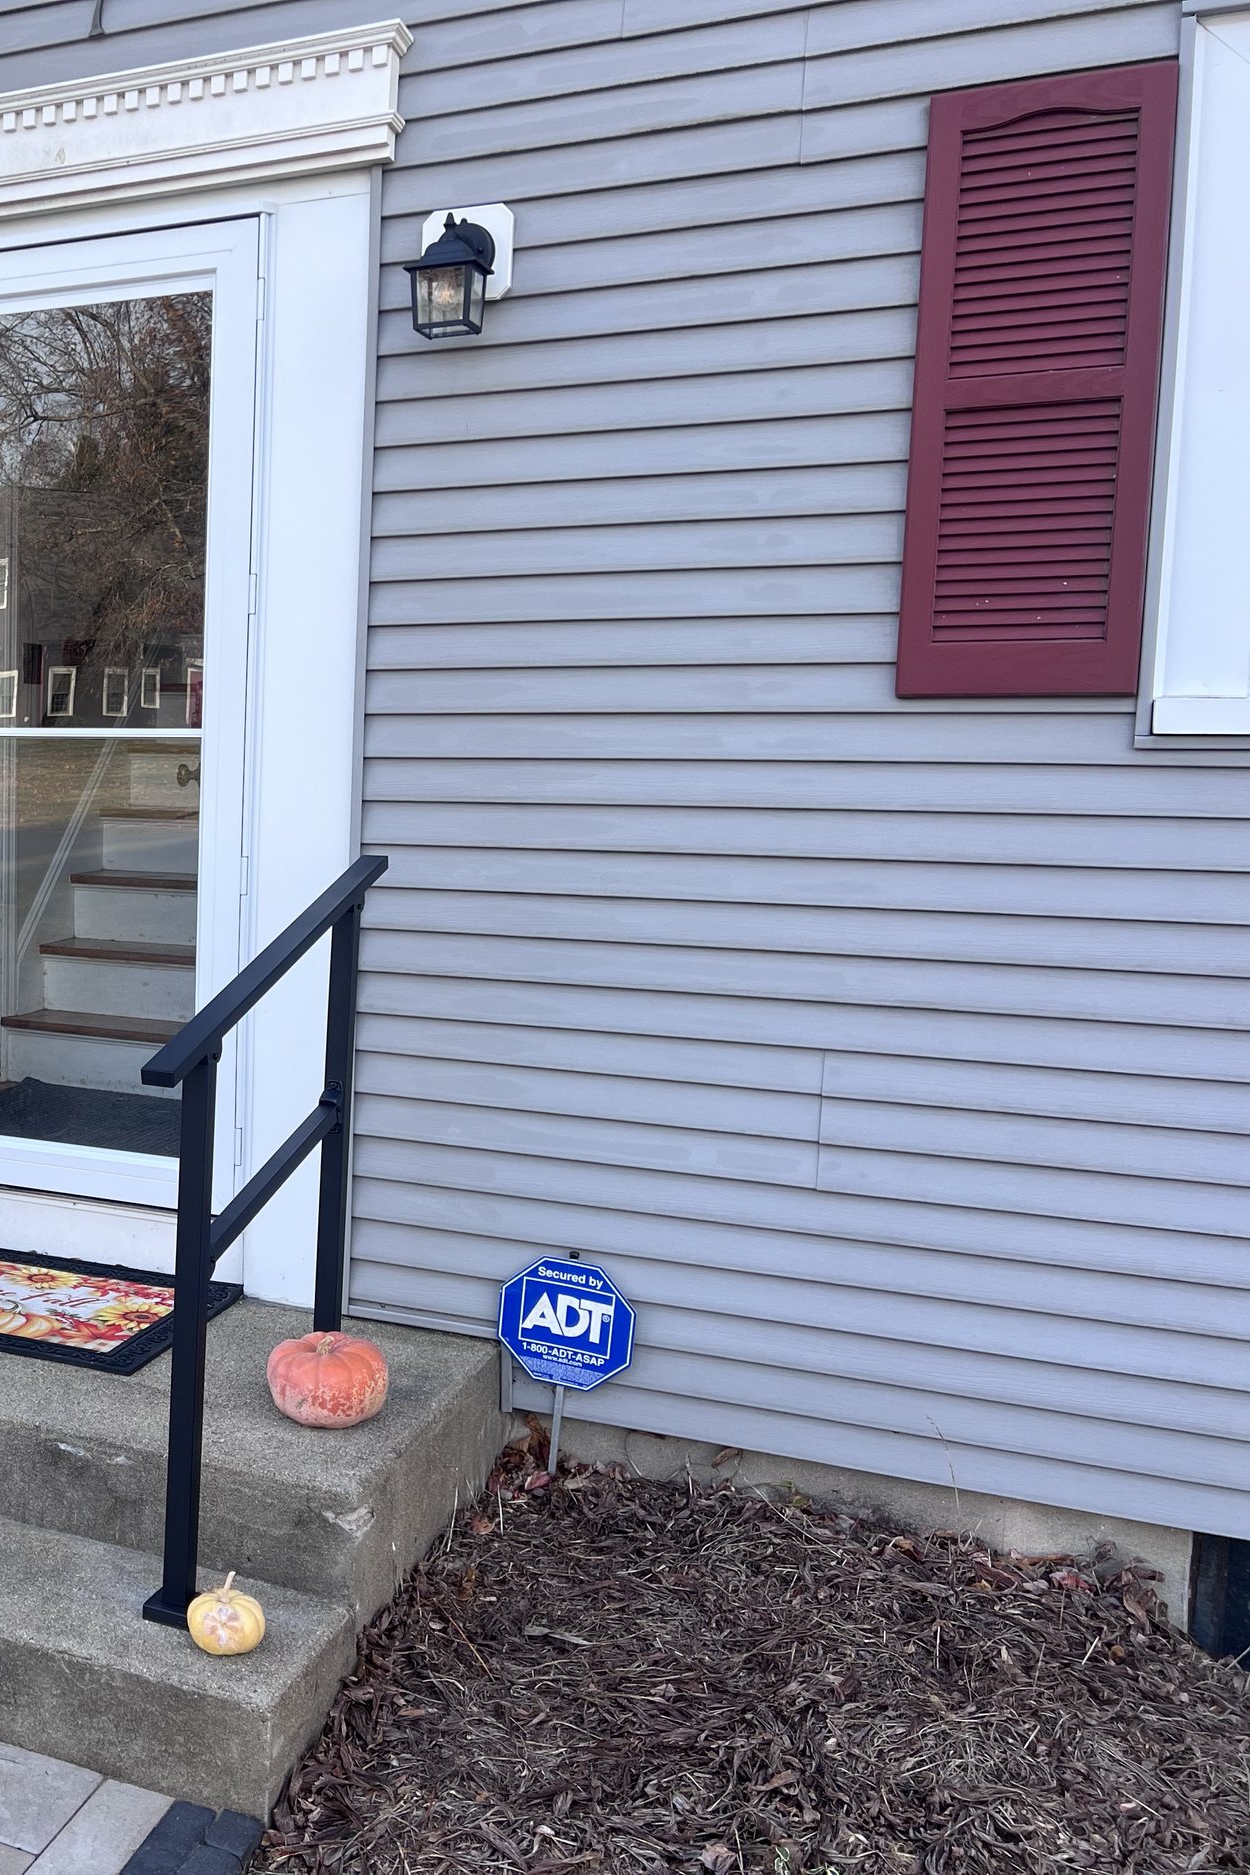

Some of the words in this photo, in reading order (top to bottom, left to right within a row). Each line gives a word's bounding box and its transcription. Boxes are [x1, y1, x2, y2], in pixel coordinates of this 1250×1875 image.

[538, 1266, 586, 1284] Secured
[589, 1276, 604, 1290] by
[521, 1291, 614, 1344] ADT
[521, 1342, 605, 1367] 1-800-ADT-ASAP
[542, 1354, 583, 1367] www.adt.com
